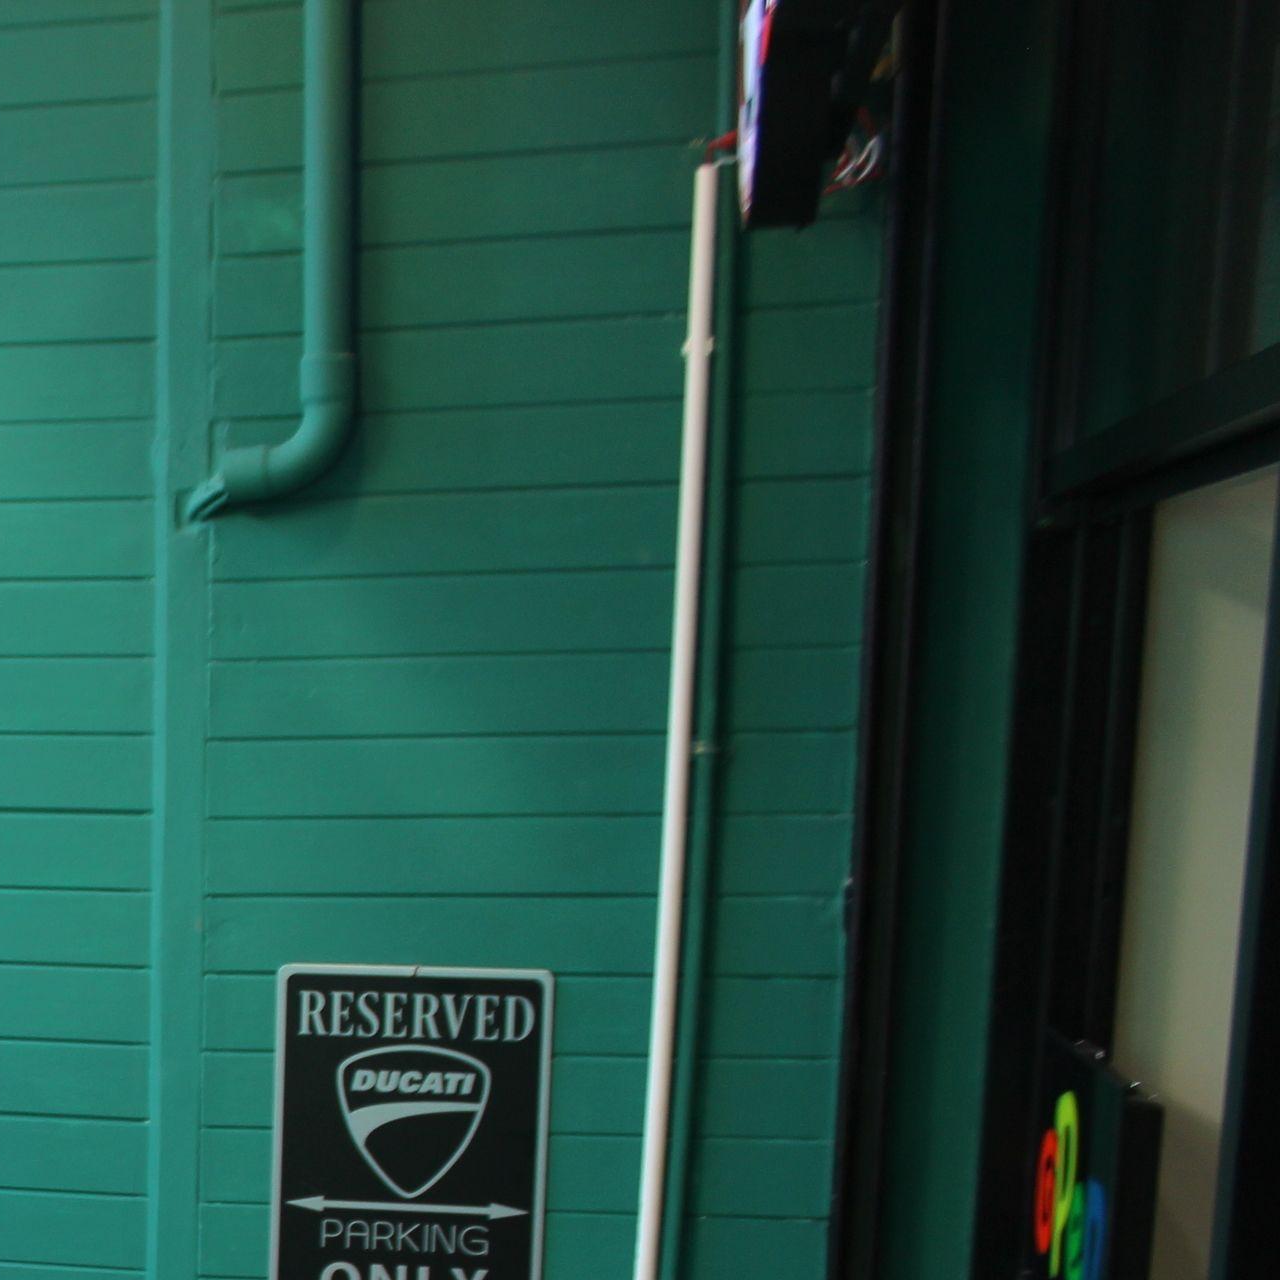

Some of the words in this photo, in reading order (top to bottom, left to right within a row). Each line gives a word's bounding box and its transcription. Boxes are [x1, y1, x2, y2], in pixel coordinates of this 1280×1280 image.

[297, 989, 536, 1043] RESERVED
[351, 1069, 477, 1096] DUCATI
[319, 1218, 490, 1256] PARKING
